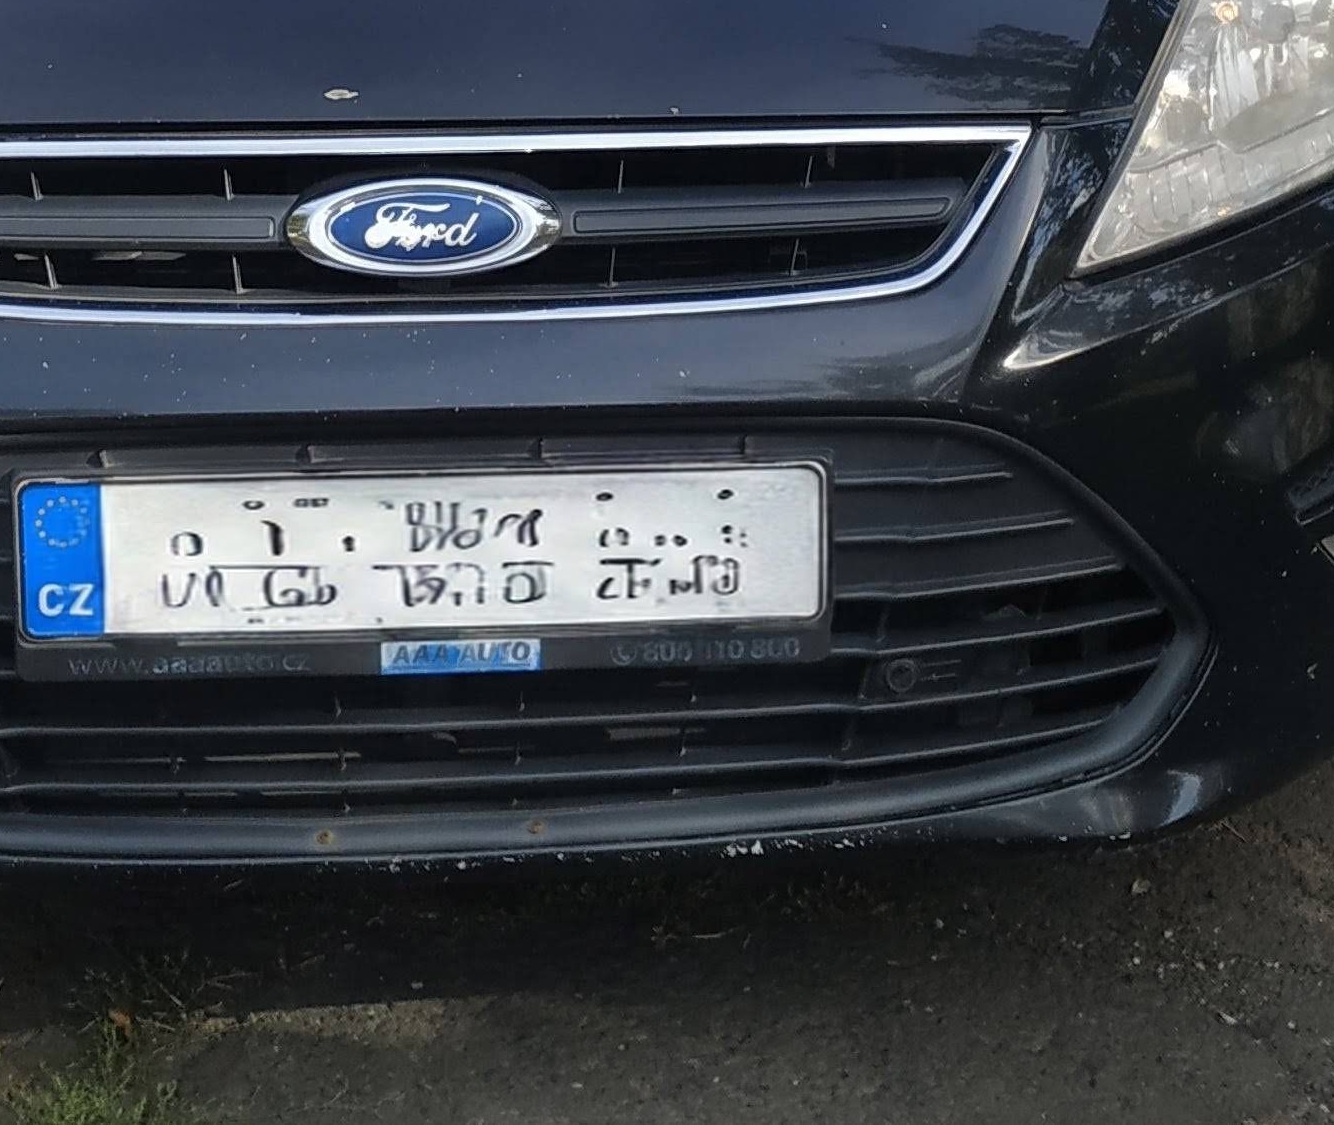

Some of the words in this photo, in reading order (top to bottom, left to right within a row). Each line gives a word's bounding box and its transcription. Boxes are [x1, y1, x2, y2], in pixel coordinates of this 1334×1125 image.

[364, 202, 479, 251] Ford
[38, 582, 96, 618] CZ
[393, 644, 451, 664] AAA
[460, 641, 531, 662] AUTO
